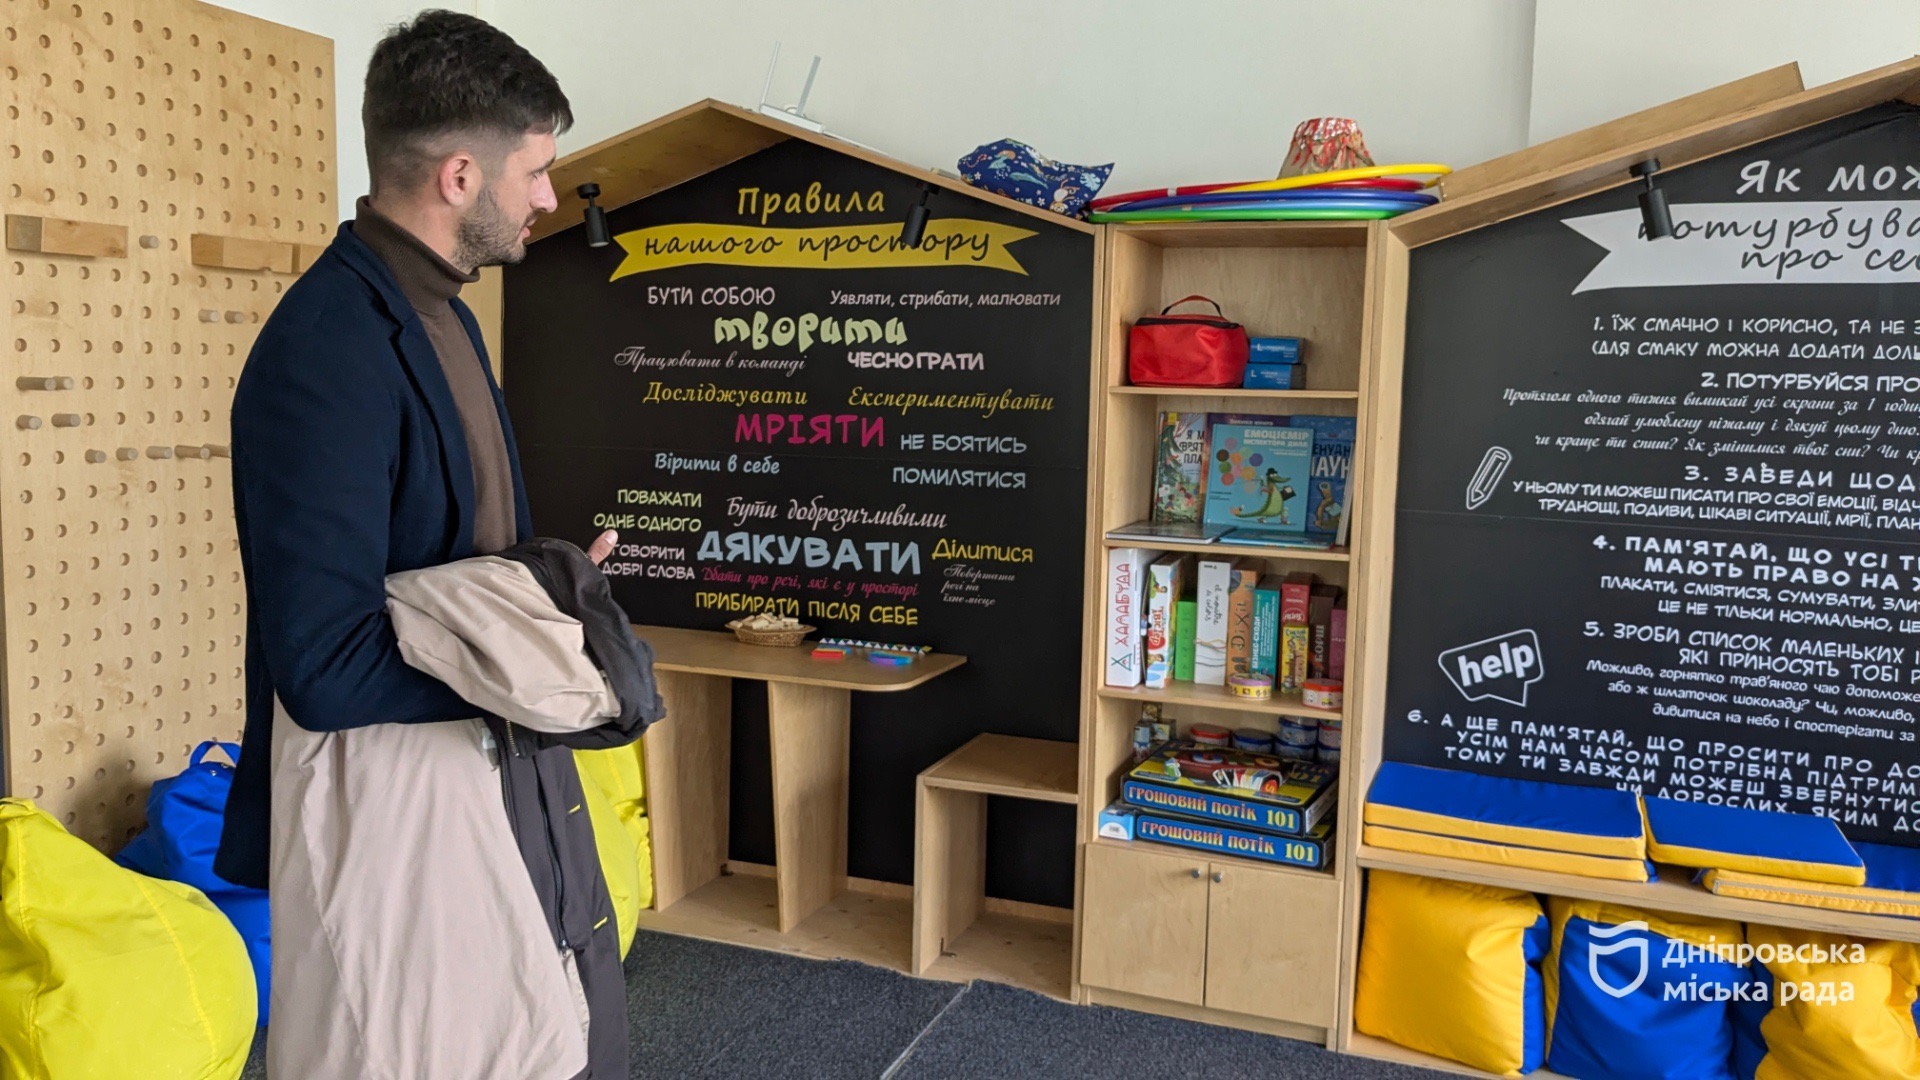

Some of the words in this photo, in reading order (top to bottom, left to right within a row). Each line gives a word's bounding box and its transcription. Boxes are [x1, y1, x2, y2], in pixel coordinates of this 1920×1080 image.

[1736, 159, 1802, 194] Як
[737, 182, 885, 224] Правила
[645, 231, 784, 256] нашого
[1741, 246, 1843, 280] про
[647, 286, 693, 306] БУТИ
[700, 287, 776, 306] СОБОЮ
[830, 290, 895, 309] Уявляти,
[899, 291, 973, 310] стрибати,
[977, 291, 1061, 307] малювати
[714, 311, 908, 353] творити
[1612, 313, 1637, 332] ЇЖ
[1643, 317, 1720, 333] СМАЧНО
[1742, 317, 1839, 337] КОРИСНО,
[1848, 319, 1872, 334] ТА
[1881, 319, 1905, 335] НЕ
[613, 346, 721, 373] Працювати
[737, 354, 807, 377] команді
[1591, 340, 1630, 356] (ДЛЯ
[1637, 341, 1699, 357] СМАКУ
[1706, 343, 1780, 358] МОЖНА
[1788, 343, 1865, 360] ДОДАТИ
[644, 381, 808, 407] Досліджувати
[1700, 372, 1719, 388] 2.
[1726, 372, 1869, 392] ПОТУРБУЙСЯ
[1876, 375, 1920, 393] ПРО
[849, 386, 1055, 419] Експериментувати
[1503, 388, 1571, 407] Протягом
[1577, 389, 1622, 404] одного
[1627, 393, 1677, 406] тижня
[1683, 391, 1749, 409] вимикай
[1751, 396, 1777, 414] усі
[1782, 398, 1836, 415] екрани
[1837, 400, 1859, 416] за
[734, 413, 885, 448] МРІЯТИ
[1584, 411, 1630, 427] одягай
[1631, 411, 1703, 433] улюблену
[1708, 418, 1766, 436] піжаму
[1785, 418, 1830, 439] дякуй
[1834, 424, 1881, 441] цьому
[1887, 421, 1920, 436] дню.
[900, 434, 925, 450] НЕ
[932, 434, 1027, 454] БОЯТИСЬ
[1555, 435, 1600, 452] краще
[1605, 437, 1627, 448] ти
[1632, 437, 1679, 451] спиш?
[1684, 438, 1706, 453] Як
[1707, 439, 1786, 457] змінилися
[1792, 441, 1830, 456] твої
[1834, 444, 1872, 458] сни?
[1877, 444, 1900, 458] Чи
[655, 453, 721, 475] Вірити
[727, 454, 738, 473] в
[743, 455, 781, 474] себе
[892, 467, 1027, 489] ПОМИЛЯТИСЯ
[1684, 465, 1709, 481] 3.
[1725, 466, 1834, 488] ЗАВЕДИ
[617, 489, 702, 508] ПОВАЖАТИ
[1525, 481, 1580, 495] НЬОМУ
[1581, 483, 1601, 496] ТИ
[1604, 485, 1667, 500] МОЖЕШ
[1670, 488, 1736, 504] ПИСАТИ
[1737, 490, 1772, 506] ПРО
[1774, 491, 1815, 507] СВОЇ
[1817, 495, 1878, 512] ЕМОЦІЇ,
[593, 513, 636, 530] ОДНЕ
[638, 514, 702, 533] ОДНОГО
[726, 496, 778, 527] Бути
[787, 495, 948, 532] доброзичливими
[1538, 499, 1620, 516] ТРУДНОЩІ,
[1624, 502, 1695, 520] ПОДИВИ,
[1699, 506, 1752, 522] ЦІКАВІ
[1754, 509, 1832, 527] СИТУАЦІЇ,
[1835, 512, 1872, 529] МРІЇ,
[696, 530, 921, 576] ДЯКУВАТИ
[931, 538, 1034, 563] Ділитися
[1592, 535, 1616, 551] 4.
[1787, 546, 1833, 565] ЩО
[1843, 551, 1888, 569] УСІ
[602, 562, 643, 577] ДОБРІ
[647, 564, 696, 581] СЛОВА
[701, 567, 742, 583] Дбати
[747, 574, 769, 591] про
[807, 577, 829, 590] які
[860, 582, 919, 602] просторі
[943, 563, 1016, 583] Повертати
[1644, 556, 1743, 578] МАЮТЬ
[1753, 564, 1851, 587] ПРАВО
[1861, 572, 1900, 591] НА
[695, 591, 799, 617] ПРИБИРАТИ
[808, 600, 861, 622] ПІСЛЯ
[869, 605, 919, 626] СЕБЕ
[1114, 562, 1131, 647] ХАЛАБУДА
[1600, 575, 1678, 595] ПЛАКАТИ,
[1683, 583, 1771, 602] СМІЯТИСЯ,
[1777, 589, 1876, 611] СУМУВАТИ,
[1658, 600, 1681, 614] ЦЕ
[1686, 601, 1708, 615] НЕ
[1714, 604, 1774, 622] ТІЛЬКИ
[1779, 609, 1893, 633] НОРМАЛЬНО,
[1583, 621, 1604, 638] 5.
[1613, 622, 1680, 644] ЗРОБИ
[1688, 630, 1773, 652] СПИСОК
[1780, 637, 1905, 665] МАЛЕНЬКИХ
[1456, 641, 1536, 687] help
[1586, 659, 1654, 679] Можливо,
[1659, 667, 1725, 685] горнятко
[1813, 683, 1840, 695] чаю
[1679, 648, 1708, 666] ЯКІ
[1719, 651, 1840, 678] ПРИНОСЯТЬ
[1849, 662, 1899, 683] ТОБІ
[1608, 680, 1632, 694] або
[1653, 685, 1728, 704] шматочок
[1733, 694, 1811, 714] шоколаду?
[1815, 700, 1839, 716] Чи,
[1843, 706, 1916, 724] можливо,
[1652, 702, 1721, 723] дивитися
[1725, 711, 1742, 724] на
[1746, 711, 1780, 729] небо
[1794, 720, 1894, 740] спостерігати
[1899, 731, 1915, 743] за
[1406, 708, 1430, 726] 6.
[1441, 713, 1454, 728] А
[1466, 715, 1499, 733] ЩЕ
[1646, 735, 1685, 753] ЩО
[1698, 740, 1811, 768] ПРОСИТИ
[1824, 754, 1874, 774] ПРО
[1456, 730, 1509, 750] УСІМ
[1520, 738, 1567, 756] НАМ
[1579, 745, 1661, 767] ЧАСОМ
[1673, 755, 1793, 782] ПОТРІБНА
[1443, 745, 1507, 766] ТОМУ
[1518, 754, 1547, 771] ТИ
[1558, 758, 1657, 784] ЗАВЖДИ
[1669, 772, 1766, 796] МОЖЕШ
[1128, 785, 1207, 814] ГРОШОВИЙ
[1141, 821, 1223, 847] ГРОШОВИЙ
[1266, 809, 1294, 830] 101
[1285, 842, 1314, 863] 101
